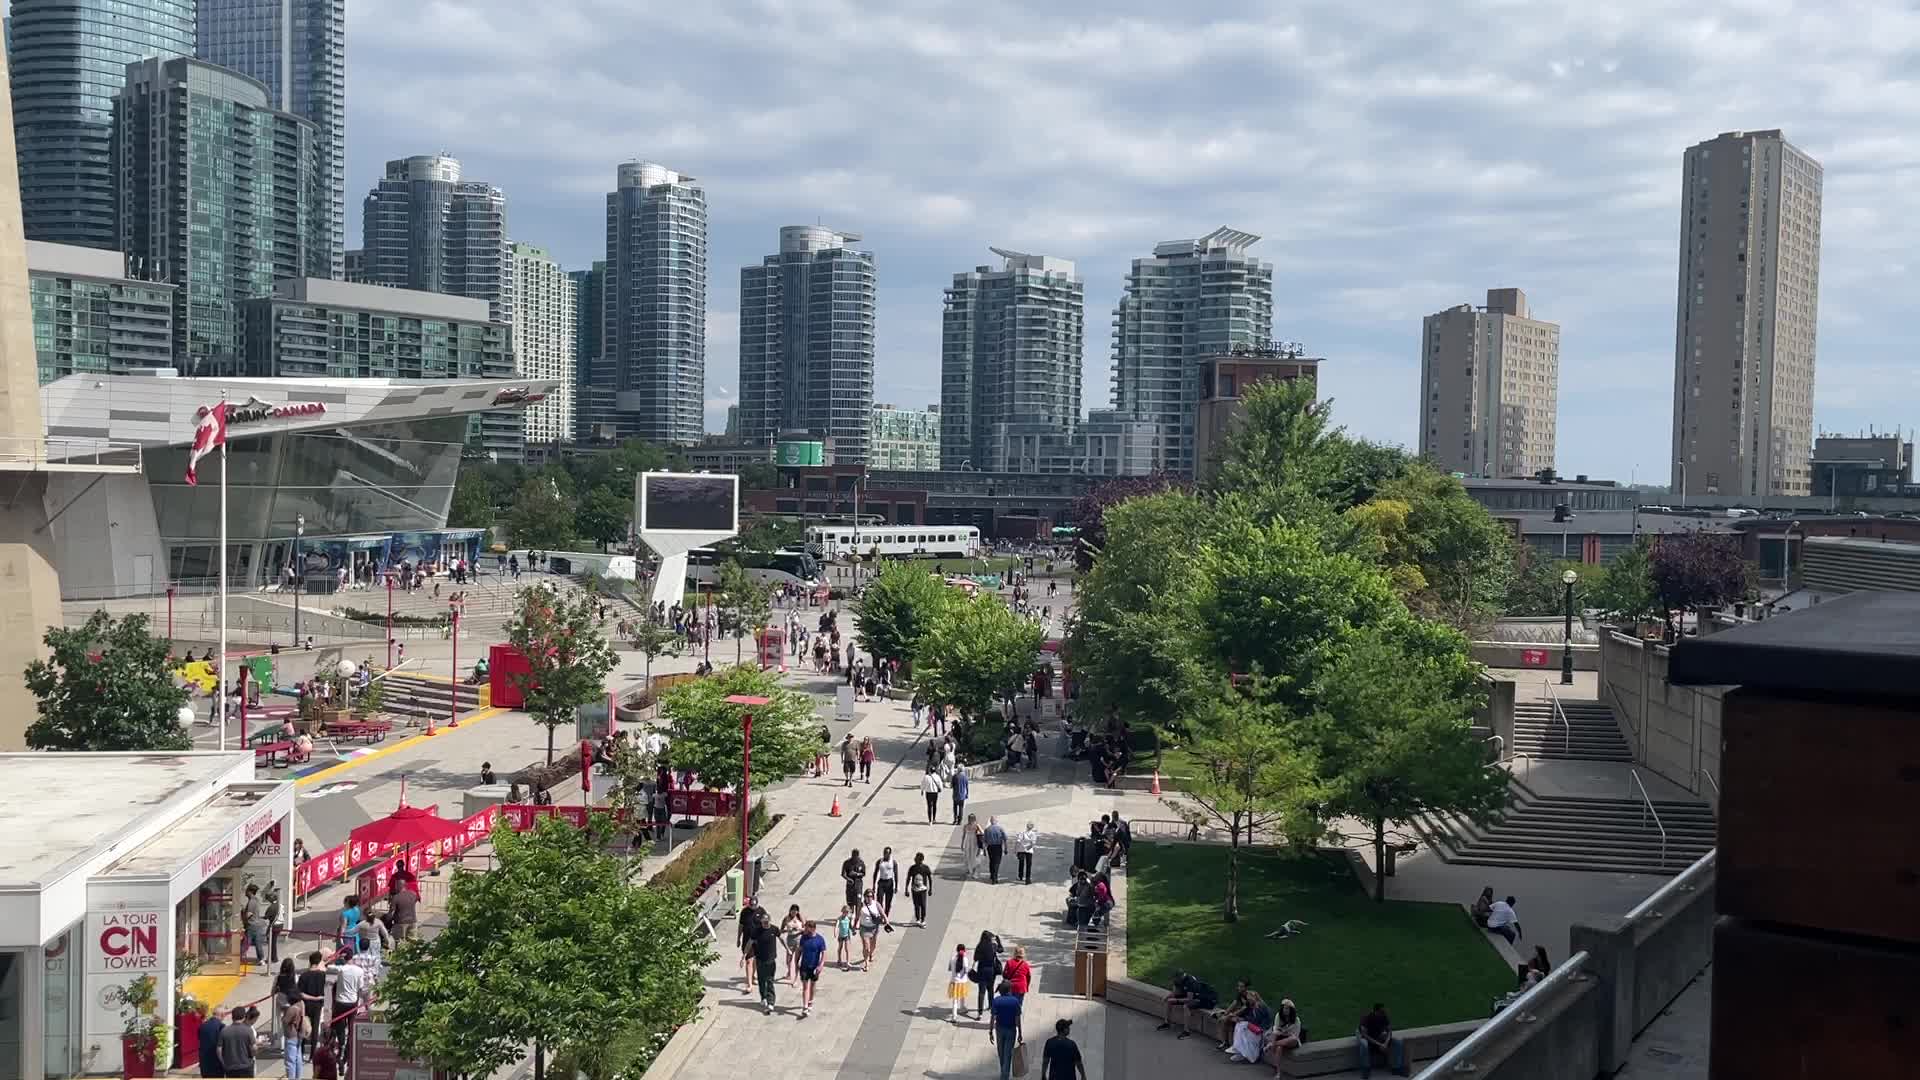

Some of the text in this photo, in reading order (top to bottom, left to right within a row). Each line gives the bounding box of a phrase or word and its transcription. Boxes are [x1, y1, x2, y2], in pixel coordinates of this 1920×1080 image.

[273, 403, 325, 417] CANADA
[701, 799, 717, 809] CN
[245, 810, 273, 844] Bienvenue
[242, 846, 280, 856] OWER
[200, 842, 230, 878] Welcome
[104, 914, 158, 925] LA TOUR
[100, 926, 158, 956] CN
[104, 957, 157, 969] TOWER
